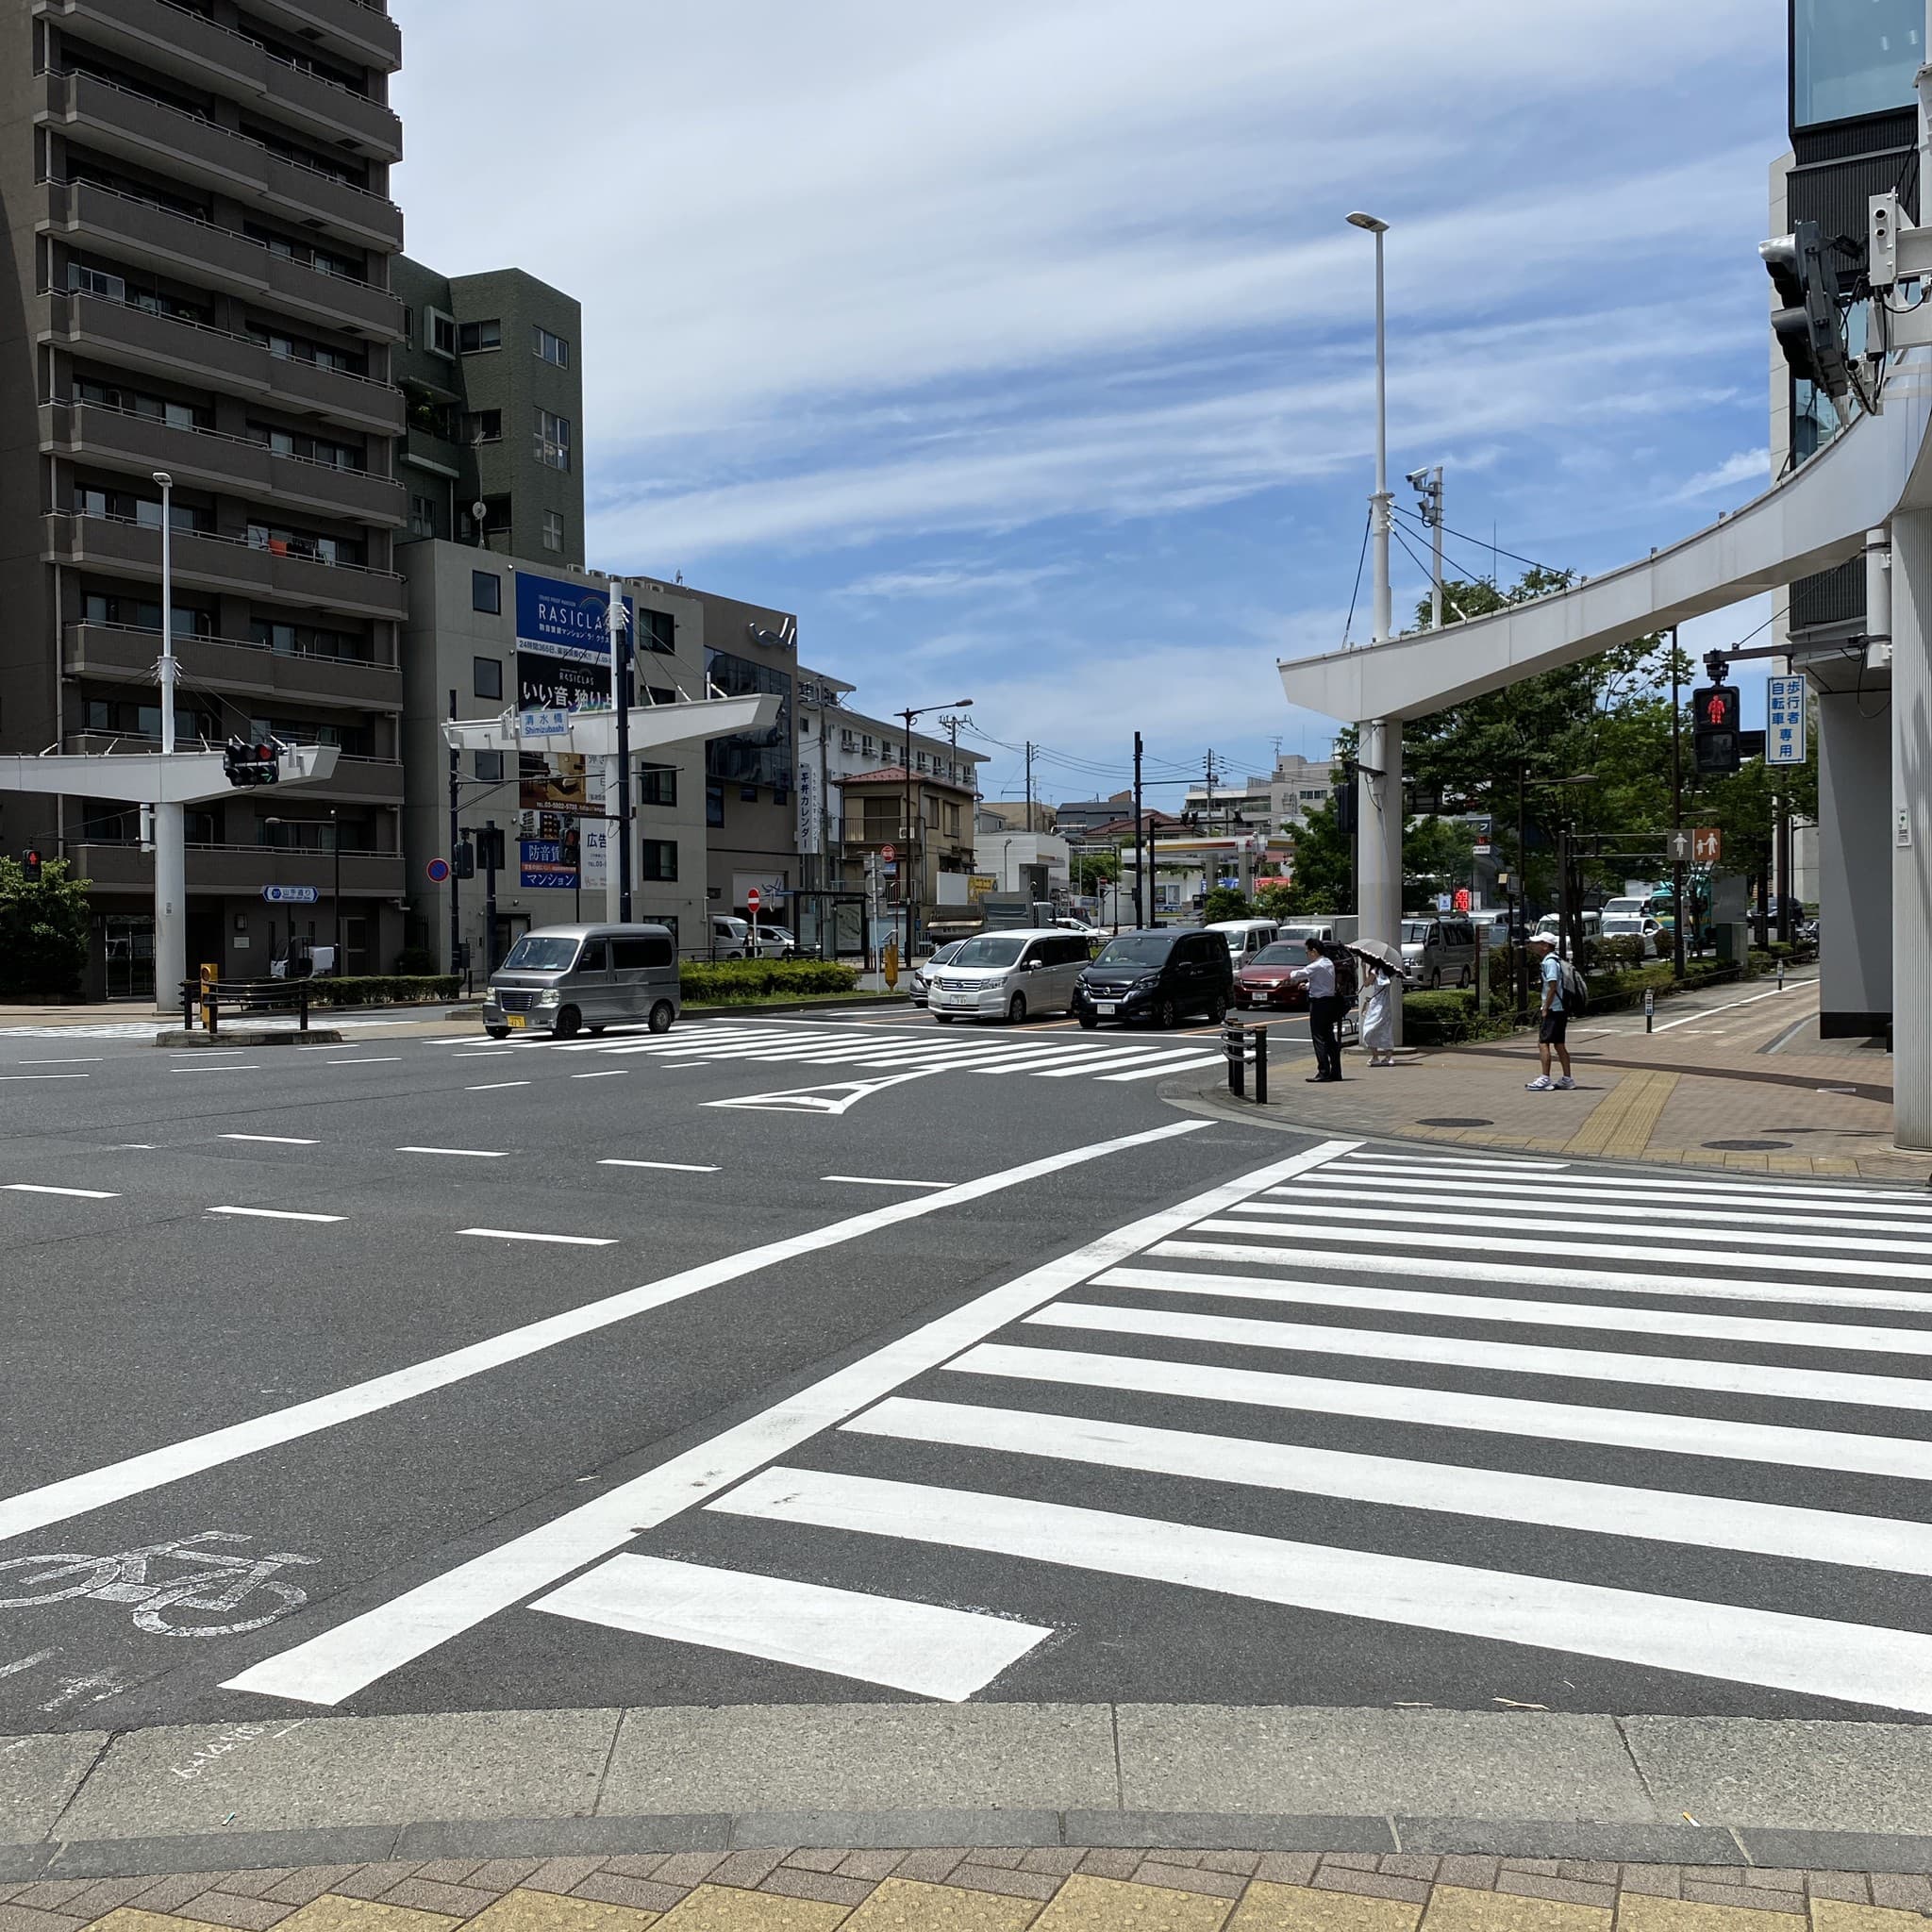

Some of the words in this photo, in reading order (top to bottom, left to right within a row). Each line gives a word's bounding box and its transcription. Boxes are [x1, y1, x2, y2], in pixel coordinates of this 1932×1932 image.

[1772, 682, 1784, 724] 自転車
[1787, 681, 1800, 724] 歩行者
[1779, 728, 1792, 758] 専用
[527, 874, 575, 886] マンション
